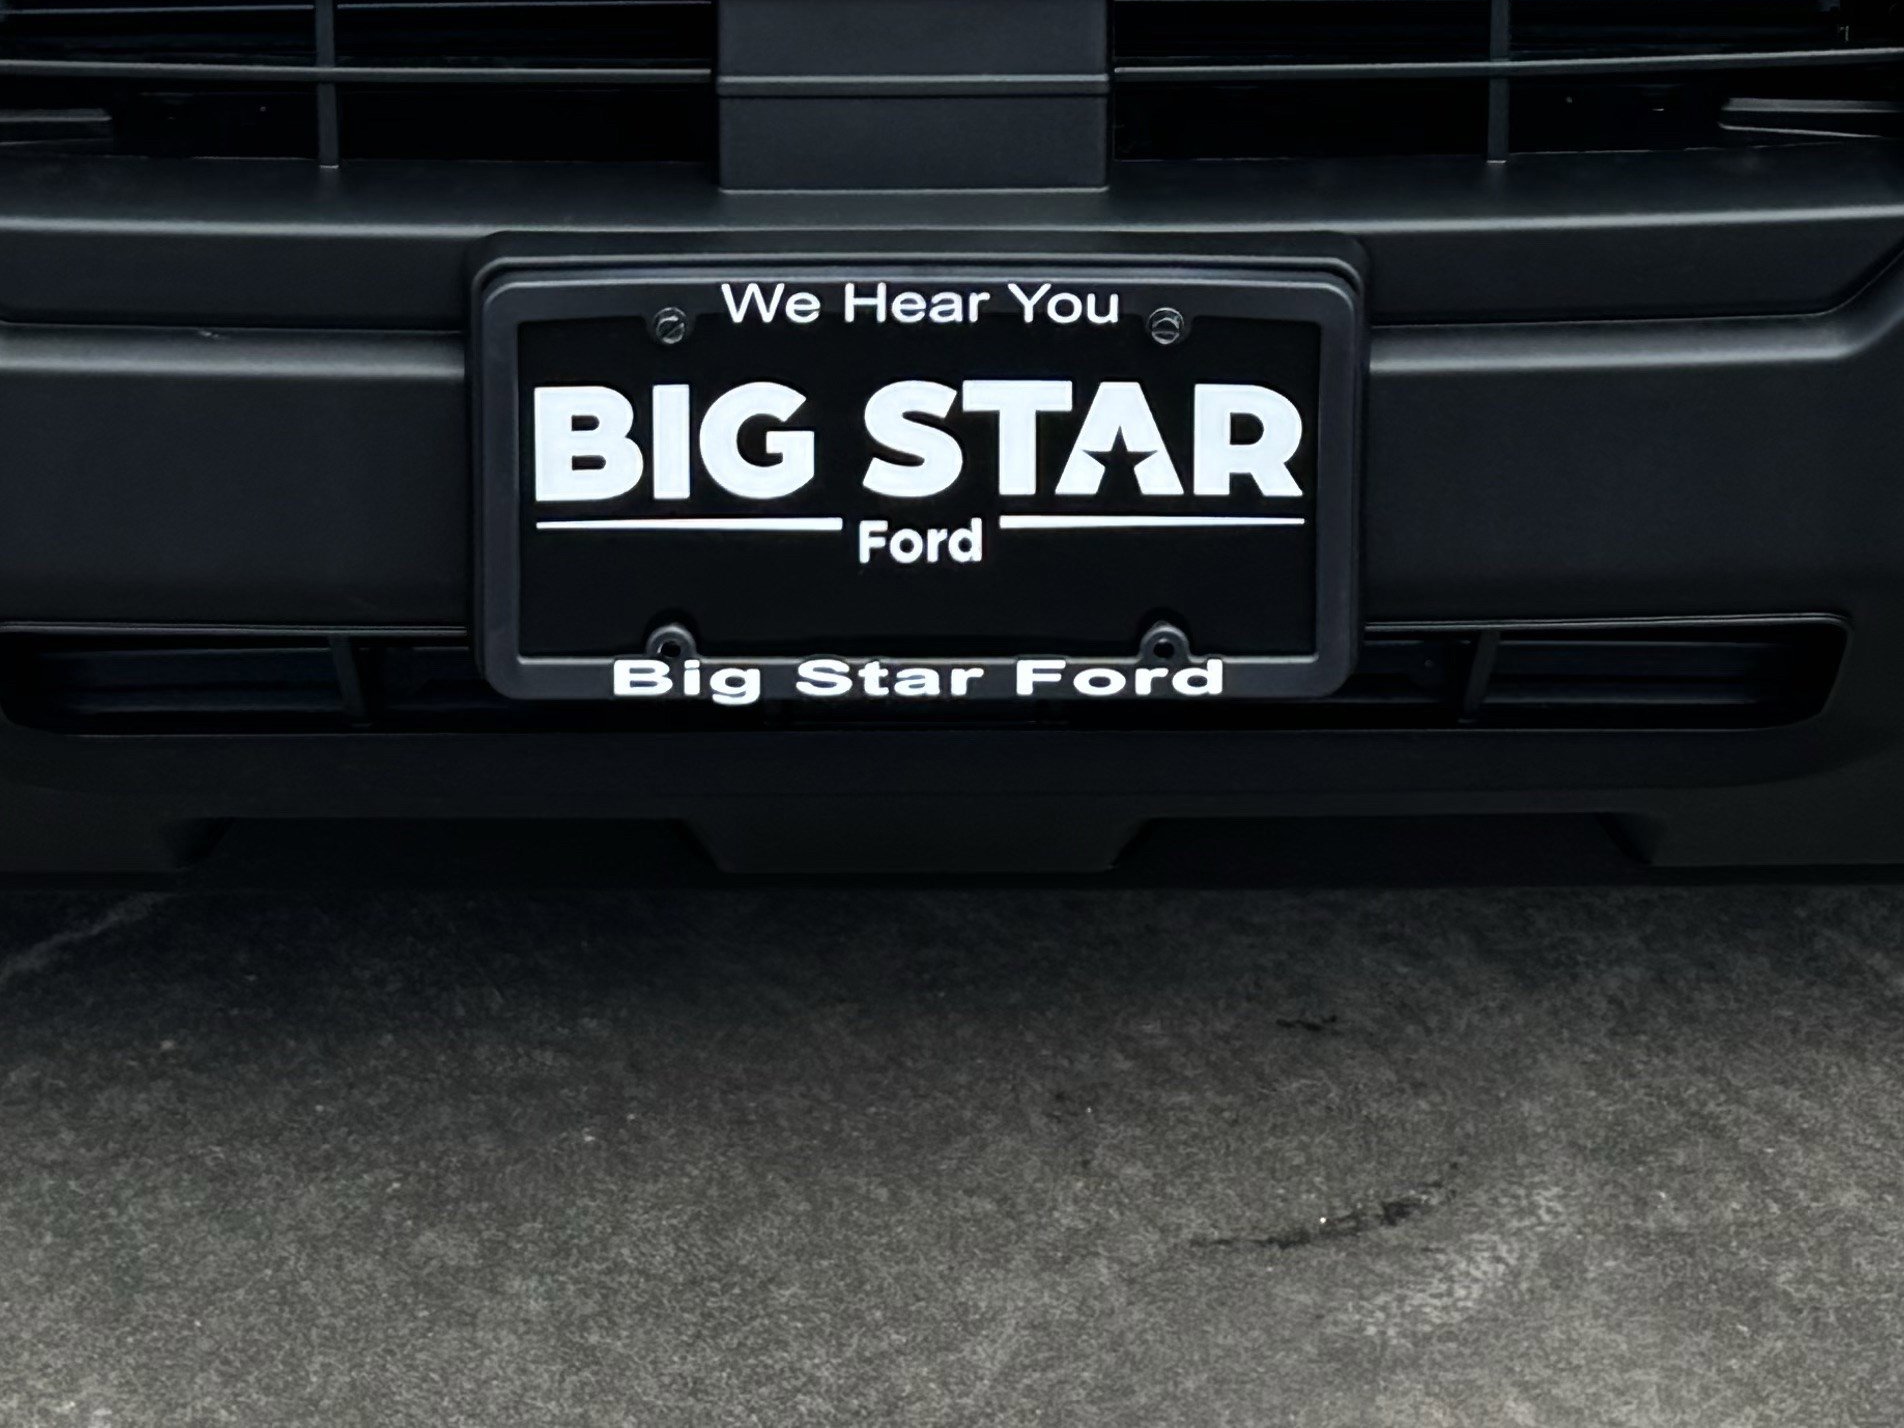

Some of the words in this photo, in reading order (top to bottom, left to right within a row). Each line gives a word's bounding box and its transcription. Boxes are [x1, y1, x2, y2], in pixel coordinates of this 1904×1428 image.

[720, 282, 821, 324] We
[844, 282, 991, 324] Hear
[1007, 282, 1120, 325] You
[532, 381, 816, 503] BIG
[862, 379, 1304, 498] STAR
[858, 517, 984, 564] Ford
[612, 659, 761, 705] Big
[795, 659, 985, 697] Star
[1016, 658, 1225, 696] Ford
